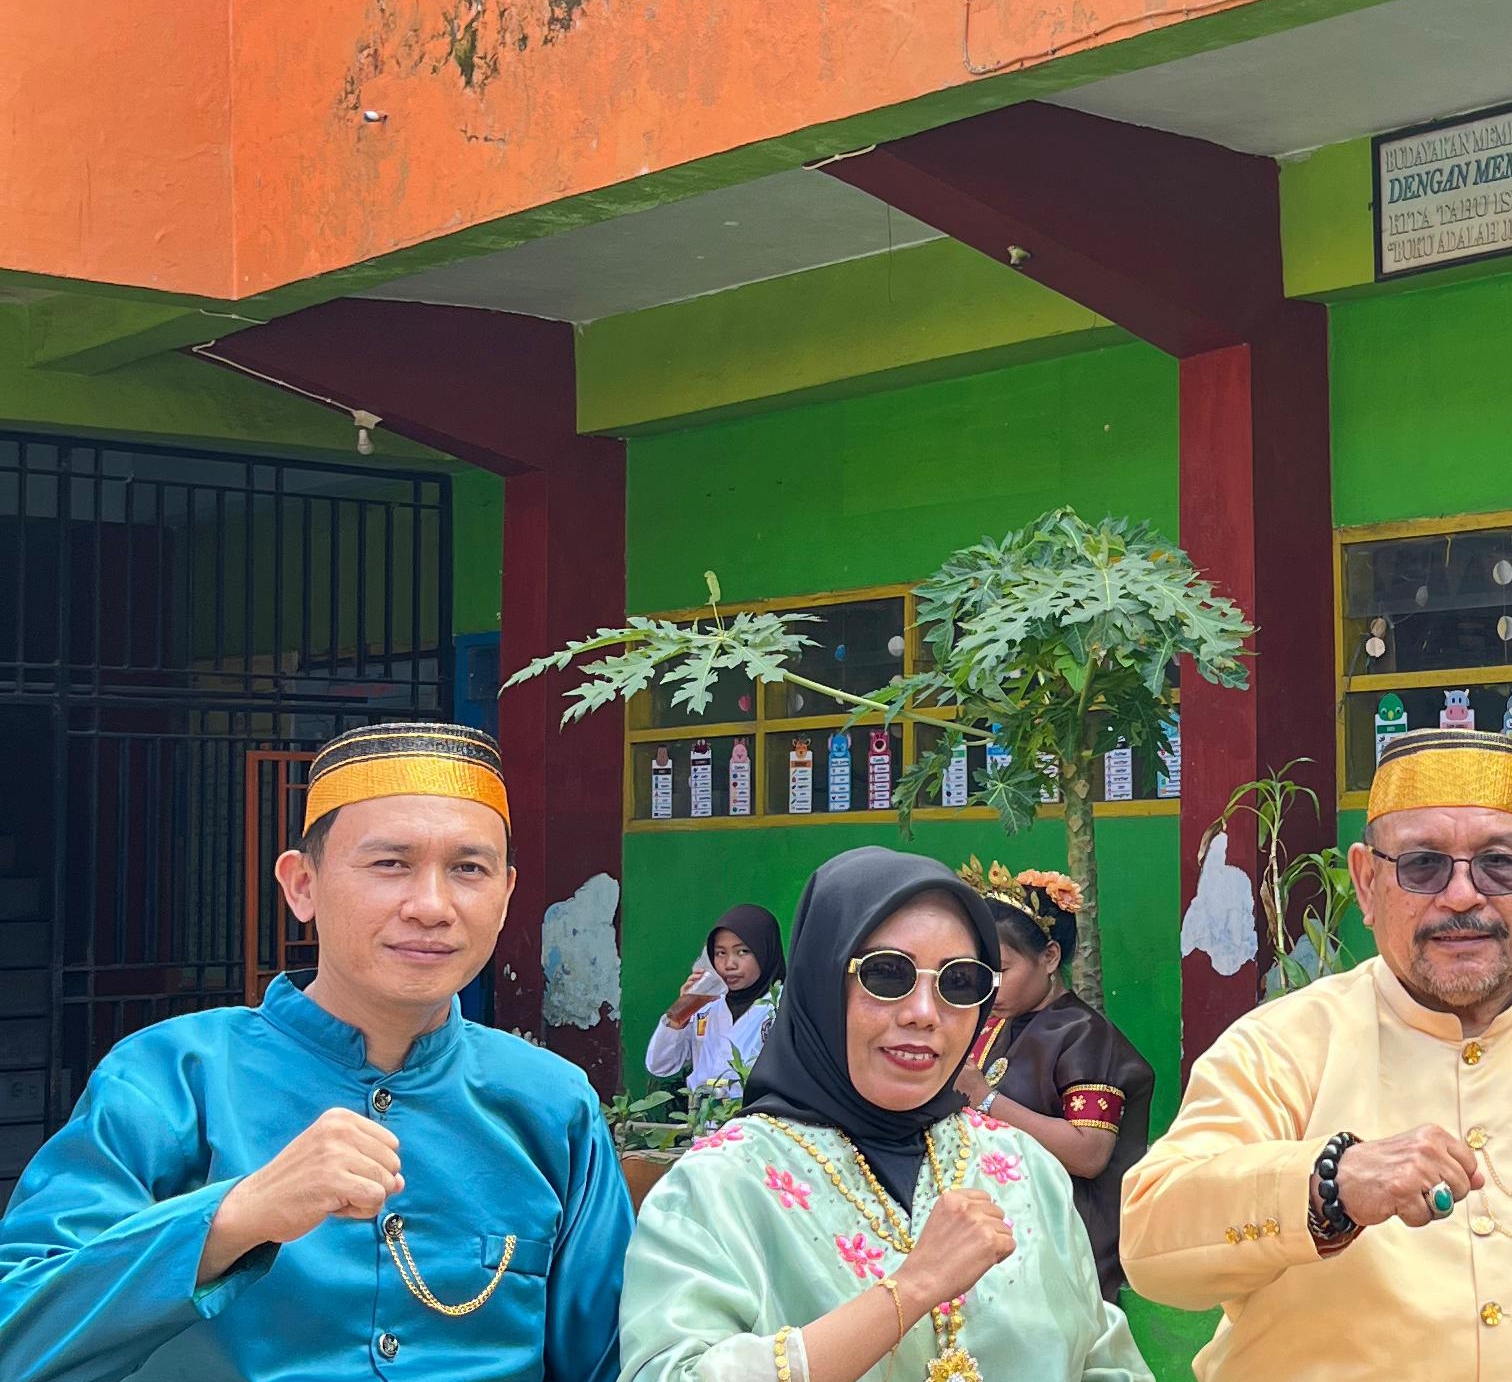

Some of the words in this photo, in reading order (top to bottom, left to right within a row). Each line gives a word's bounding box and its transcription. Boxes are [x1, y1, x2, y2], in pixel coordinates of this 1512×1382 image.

[1385, 137, 1471, 173] BUDAYAKAN
[1388, 161, 1471, 204] DENGAN
[1389, 210, 1433, 237] KITA
[1436, 195, 1489, 228] TAHU
[1436, 223, 1498, 255] ADALAH
